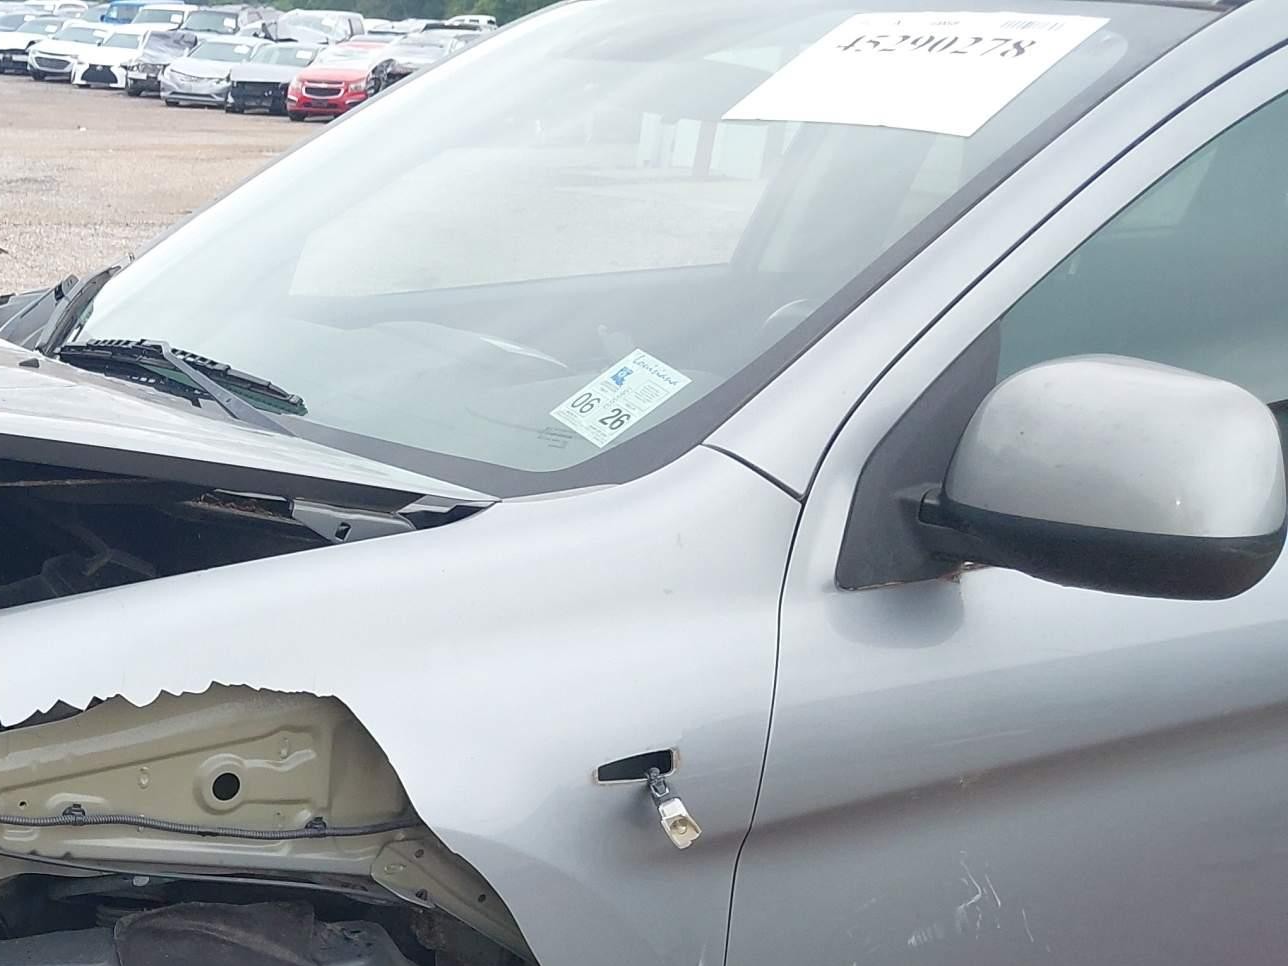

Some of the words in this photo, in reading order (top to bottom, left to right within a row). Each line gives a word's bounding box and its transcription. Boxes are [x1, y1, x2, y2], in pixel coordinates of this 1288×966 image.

[837, 36, 1036, 57] 45290278
[571, 392, 601, 414] 06
[598, 408, 631, 430] 26
